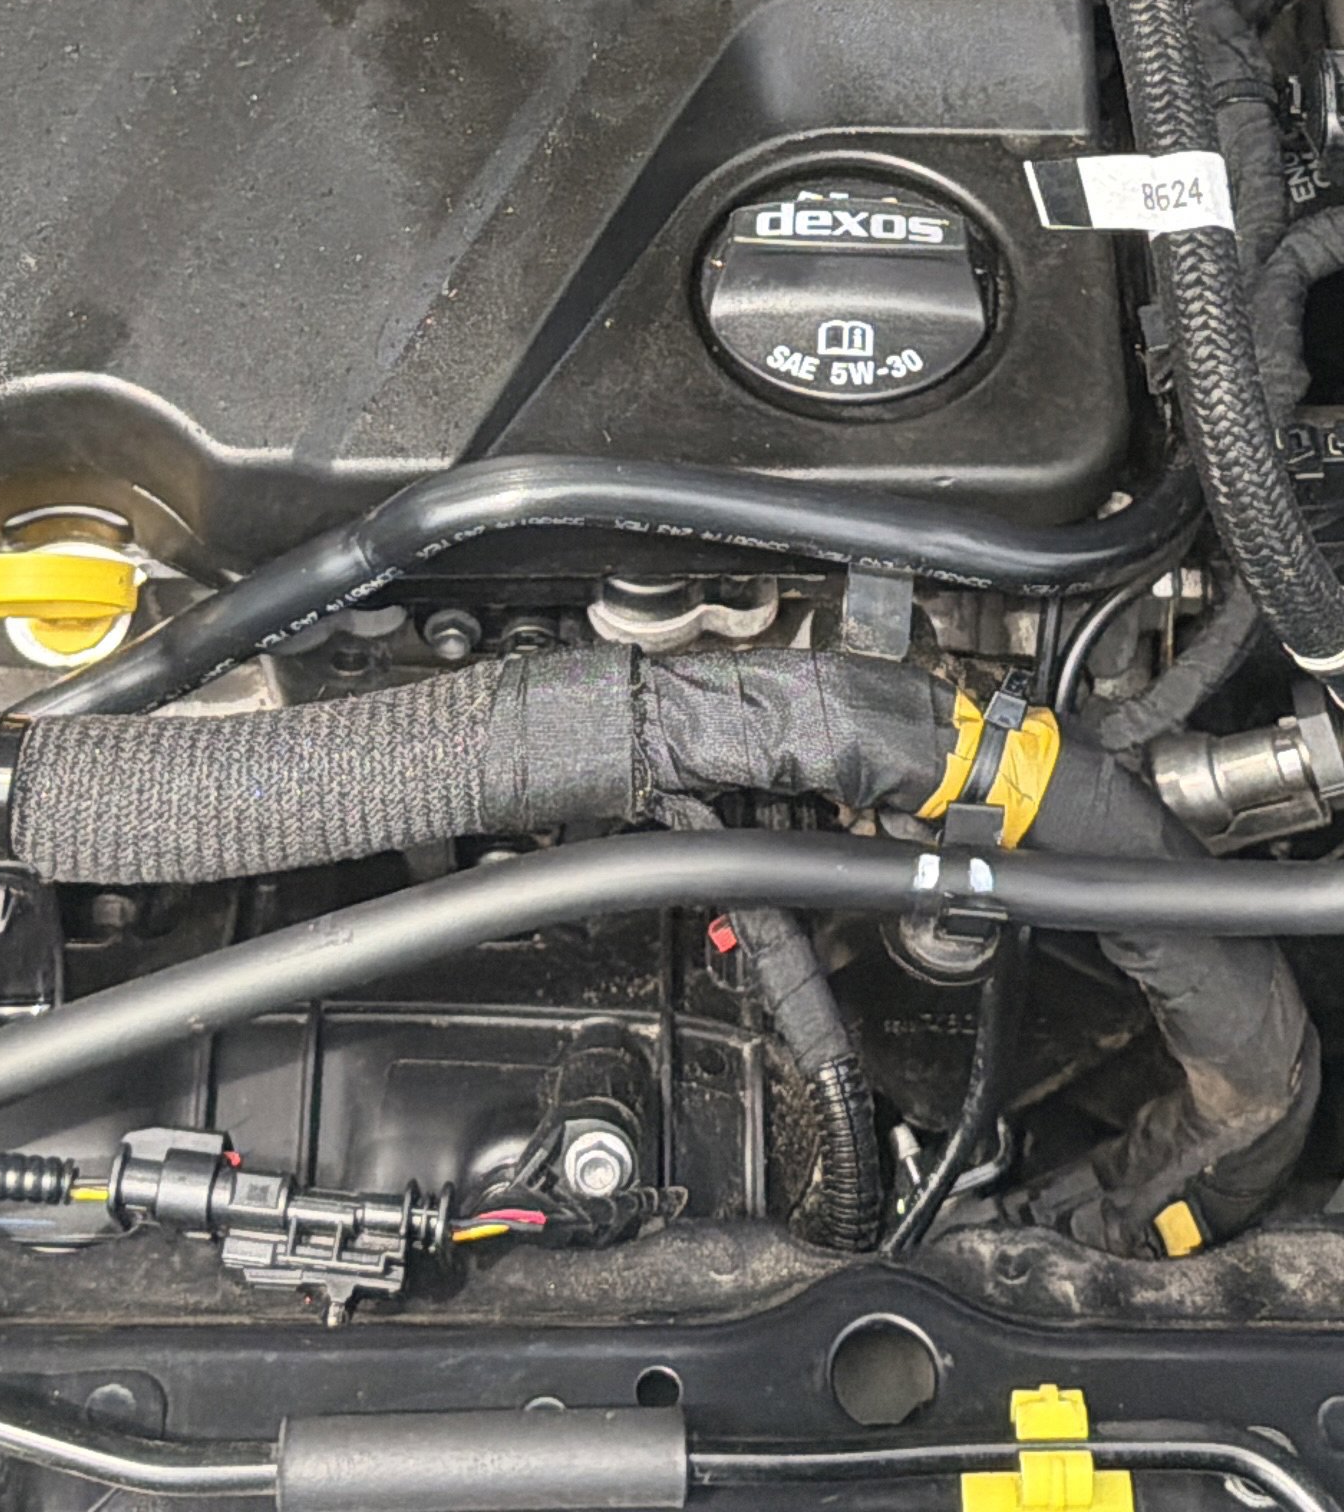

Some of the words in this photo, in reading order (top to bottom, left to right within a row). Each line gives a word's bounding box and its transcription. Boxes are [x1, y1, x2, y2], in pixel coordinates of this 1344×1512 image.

[1141, 177, 1204, 211] 8624
[756, 202, 949, 244] dexos
[766, 345, 820, 381] SAE
[829, 349, 924, 385] 5W-30
